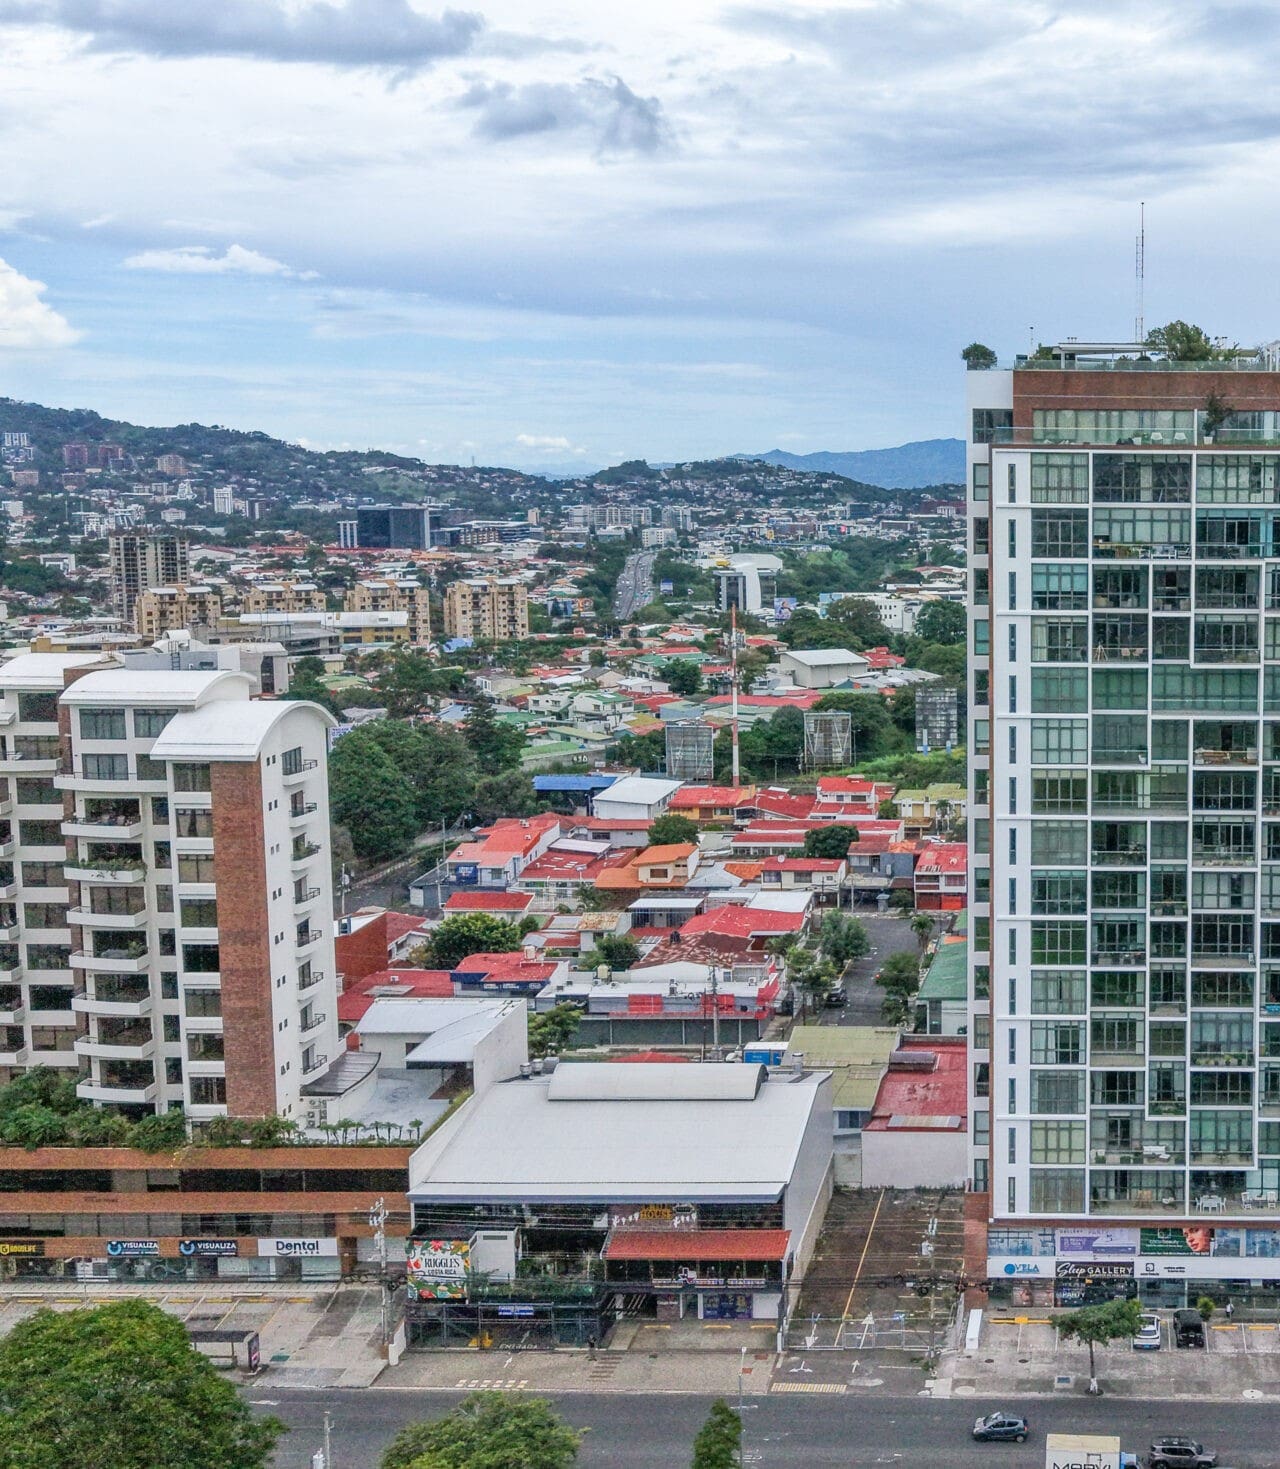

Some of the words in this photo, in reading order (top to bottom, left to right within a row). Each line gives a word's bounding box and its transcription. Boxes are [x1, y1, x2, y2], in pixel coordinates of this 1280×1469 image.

[197, 1242, 237, 1250] VISUALIZA
[276, 1240, 319, 1250] Dental
[424, 1258, 460, 1268] RUGGLES
[1057, 1262, 1086, 1278] Sleep
[1087, 1266, 1133, 1274] GALLERY
